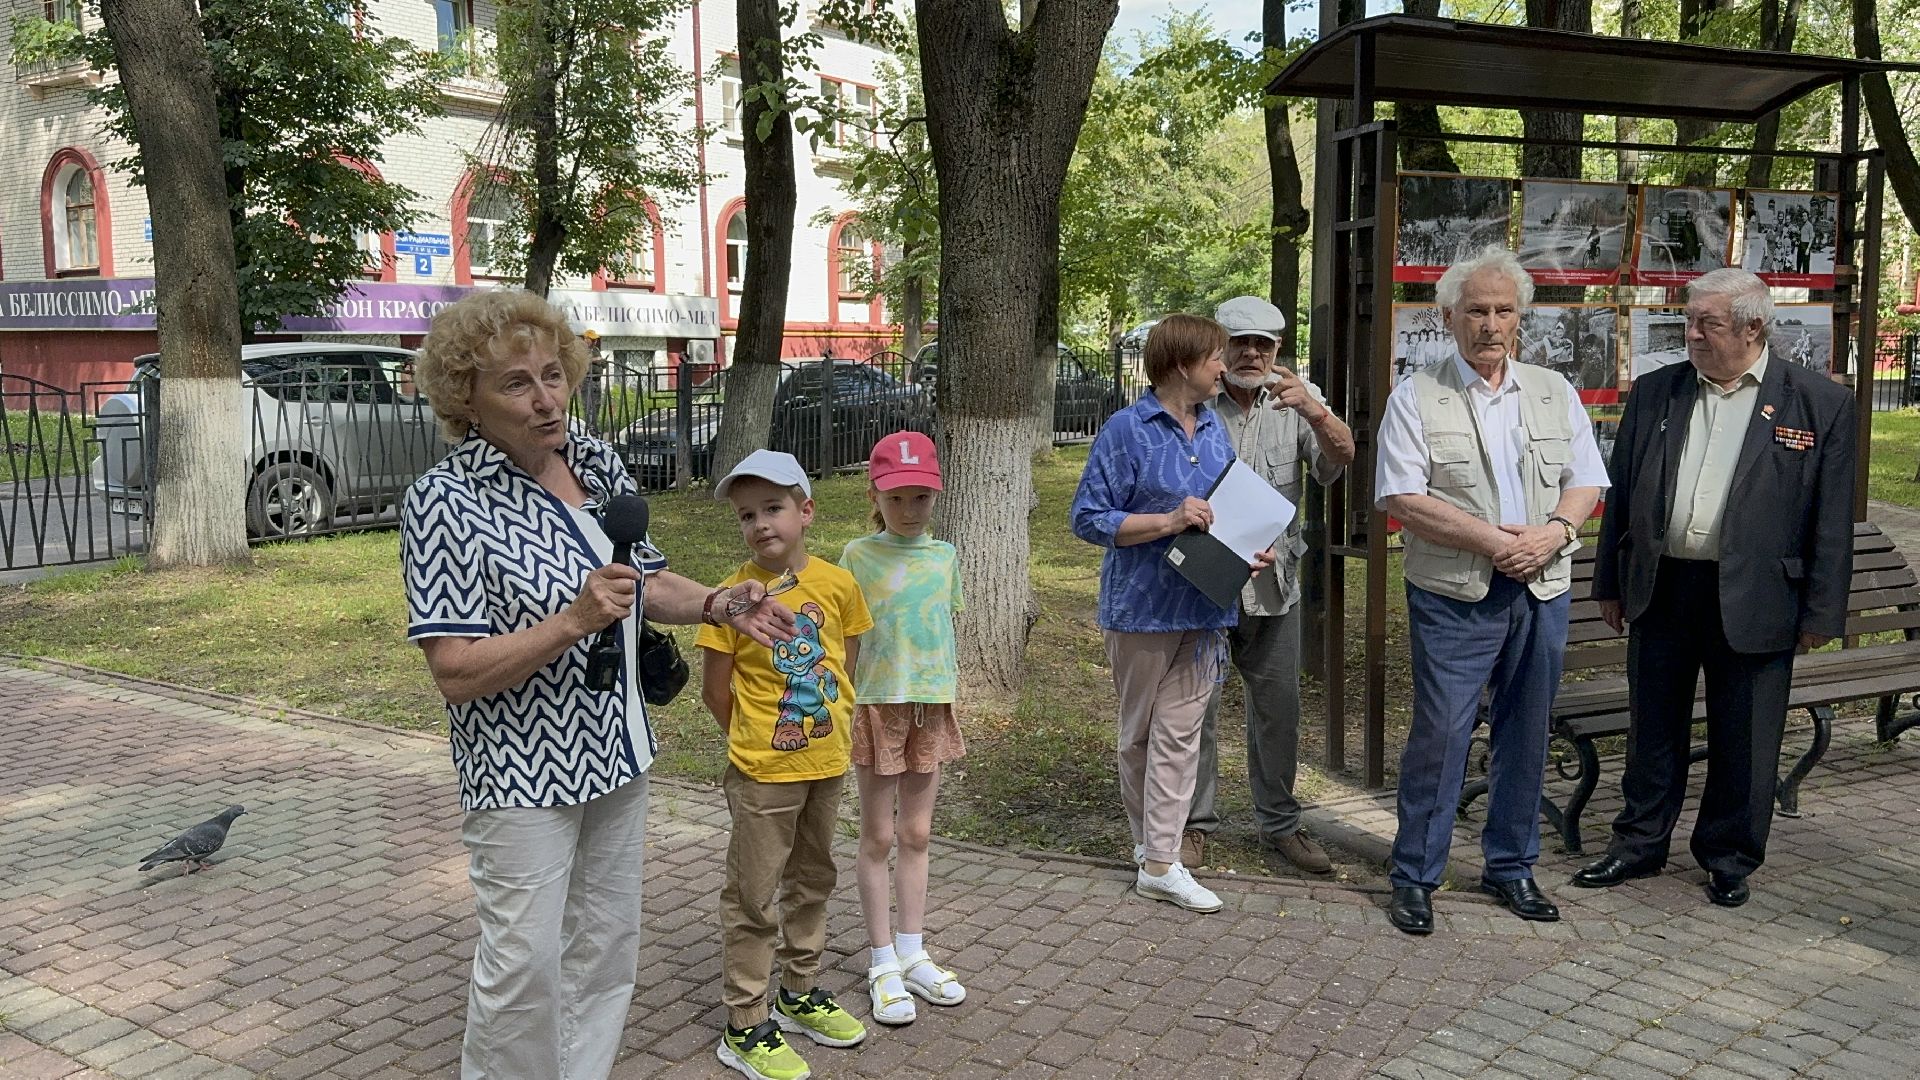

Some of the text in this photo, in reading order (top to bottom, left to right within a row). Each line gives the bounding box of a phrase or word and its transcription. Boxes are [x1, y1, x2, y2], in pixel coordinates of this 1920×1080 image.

[419, 258, 429, 272] 2
[8, 289, 158, 318] БЕЛИССИМО-МЕ
[584, 304, 718, 327] БЕЛИССИМО-МЕД
[899, 440, 920, 465] L
